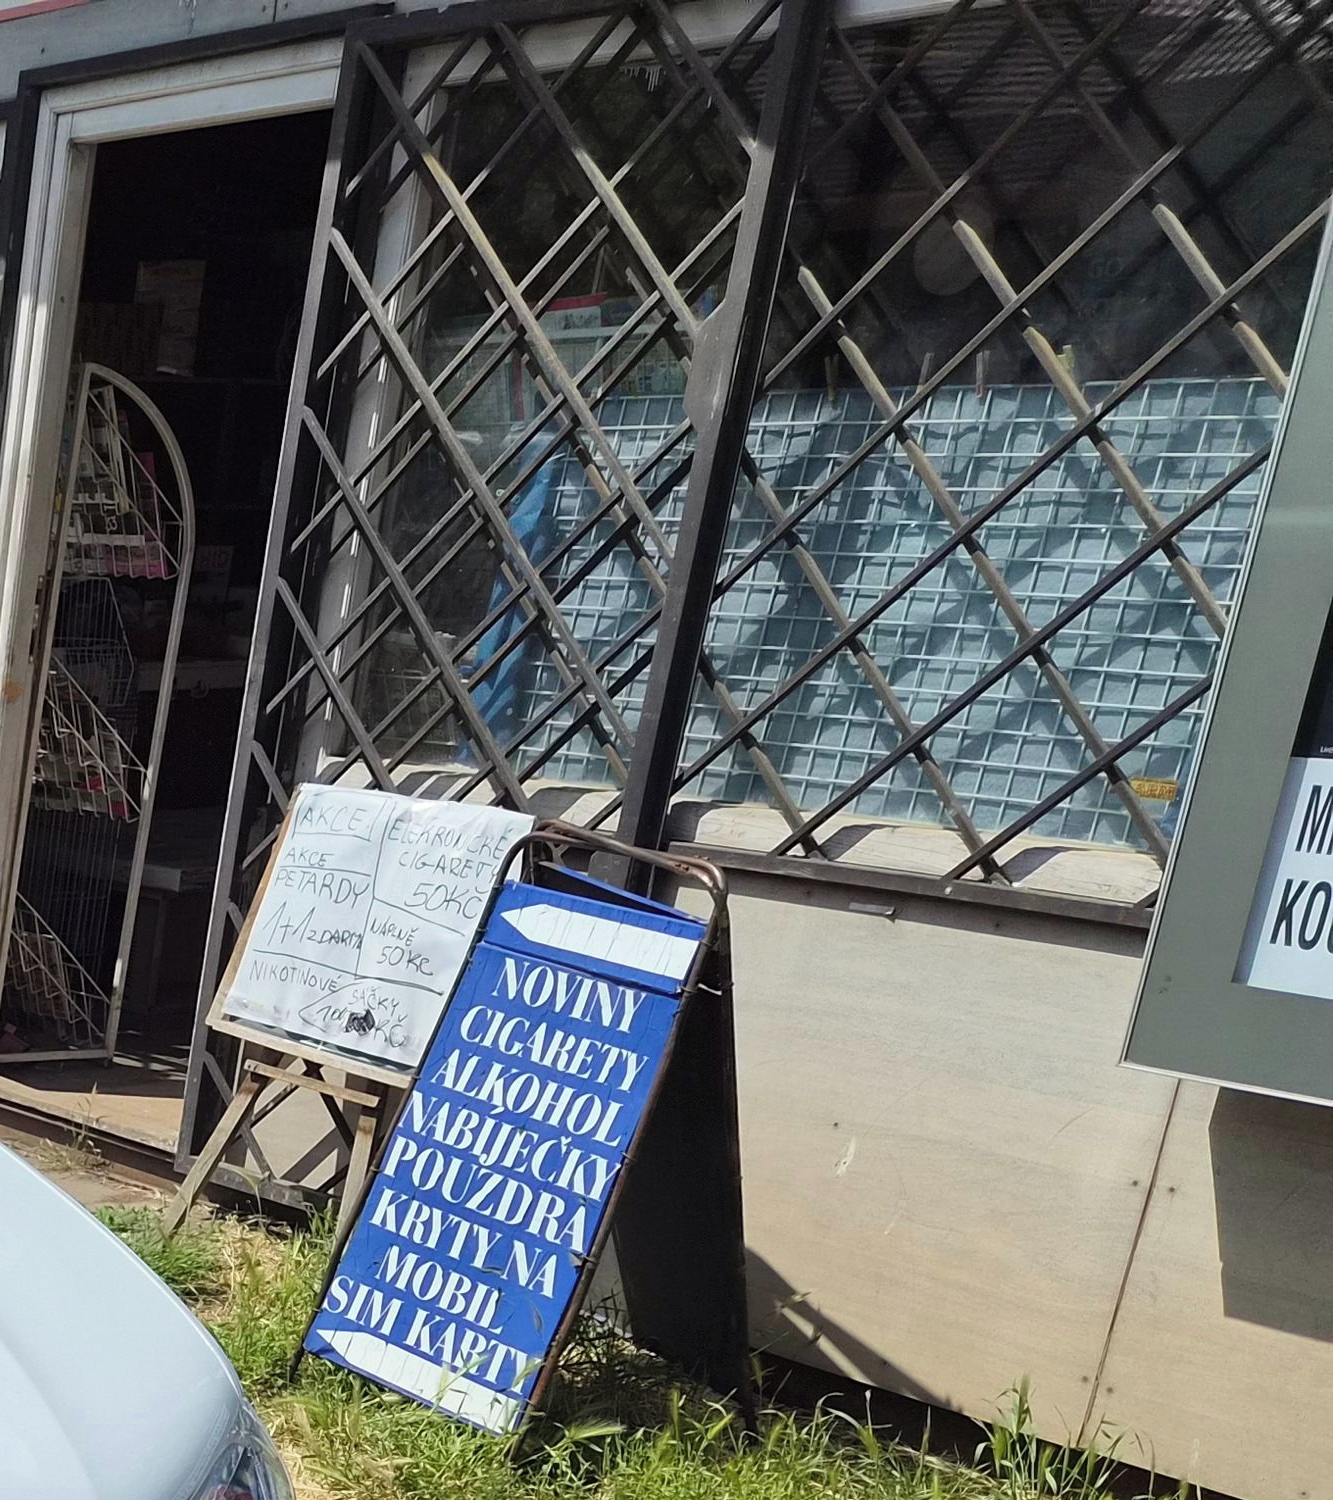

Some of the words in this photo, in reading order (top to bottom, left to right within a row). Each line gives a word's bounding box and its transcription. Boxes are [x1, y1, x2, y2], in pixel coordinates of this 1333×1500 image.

[285, 847, 335, 868] AKCE
[299, 806, 368, 833] AKCE
[1294, 784, 1333, 856] M
[274, 868, 371, 910] PETARDY
[1269, 877, 1333, 955] KO
[491, 957, 647, 1034] NOVINY
[460, 1005, 649, 1093] CIGARETY
[430, 1048, 624, 1147] ALKOHOL
[398, 1089, 621, 1202] NABÍJEČKY
[383, 1135, 586, 1252] POUZDRA
[369, 1186, 503, 1270] KRYTY
[500, 1239, 558, 1299] NA
[375, 1244, 505, 1335] MOBIL
[322, 1274, 405, 1337] SIM
[402, 1307, 542, 1396] KARTY
